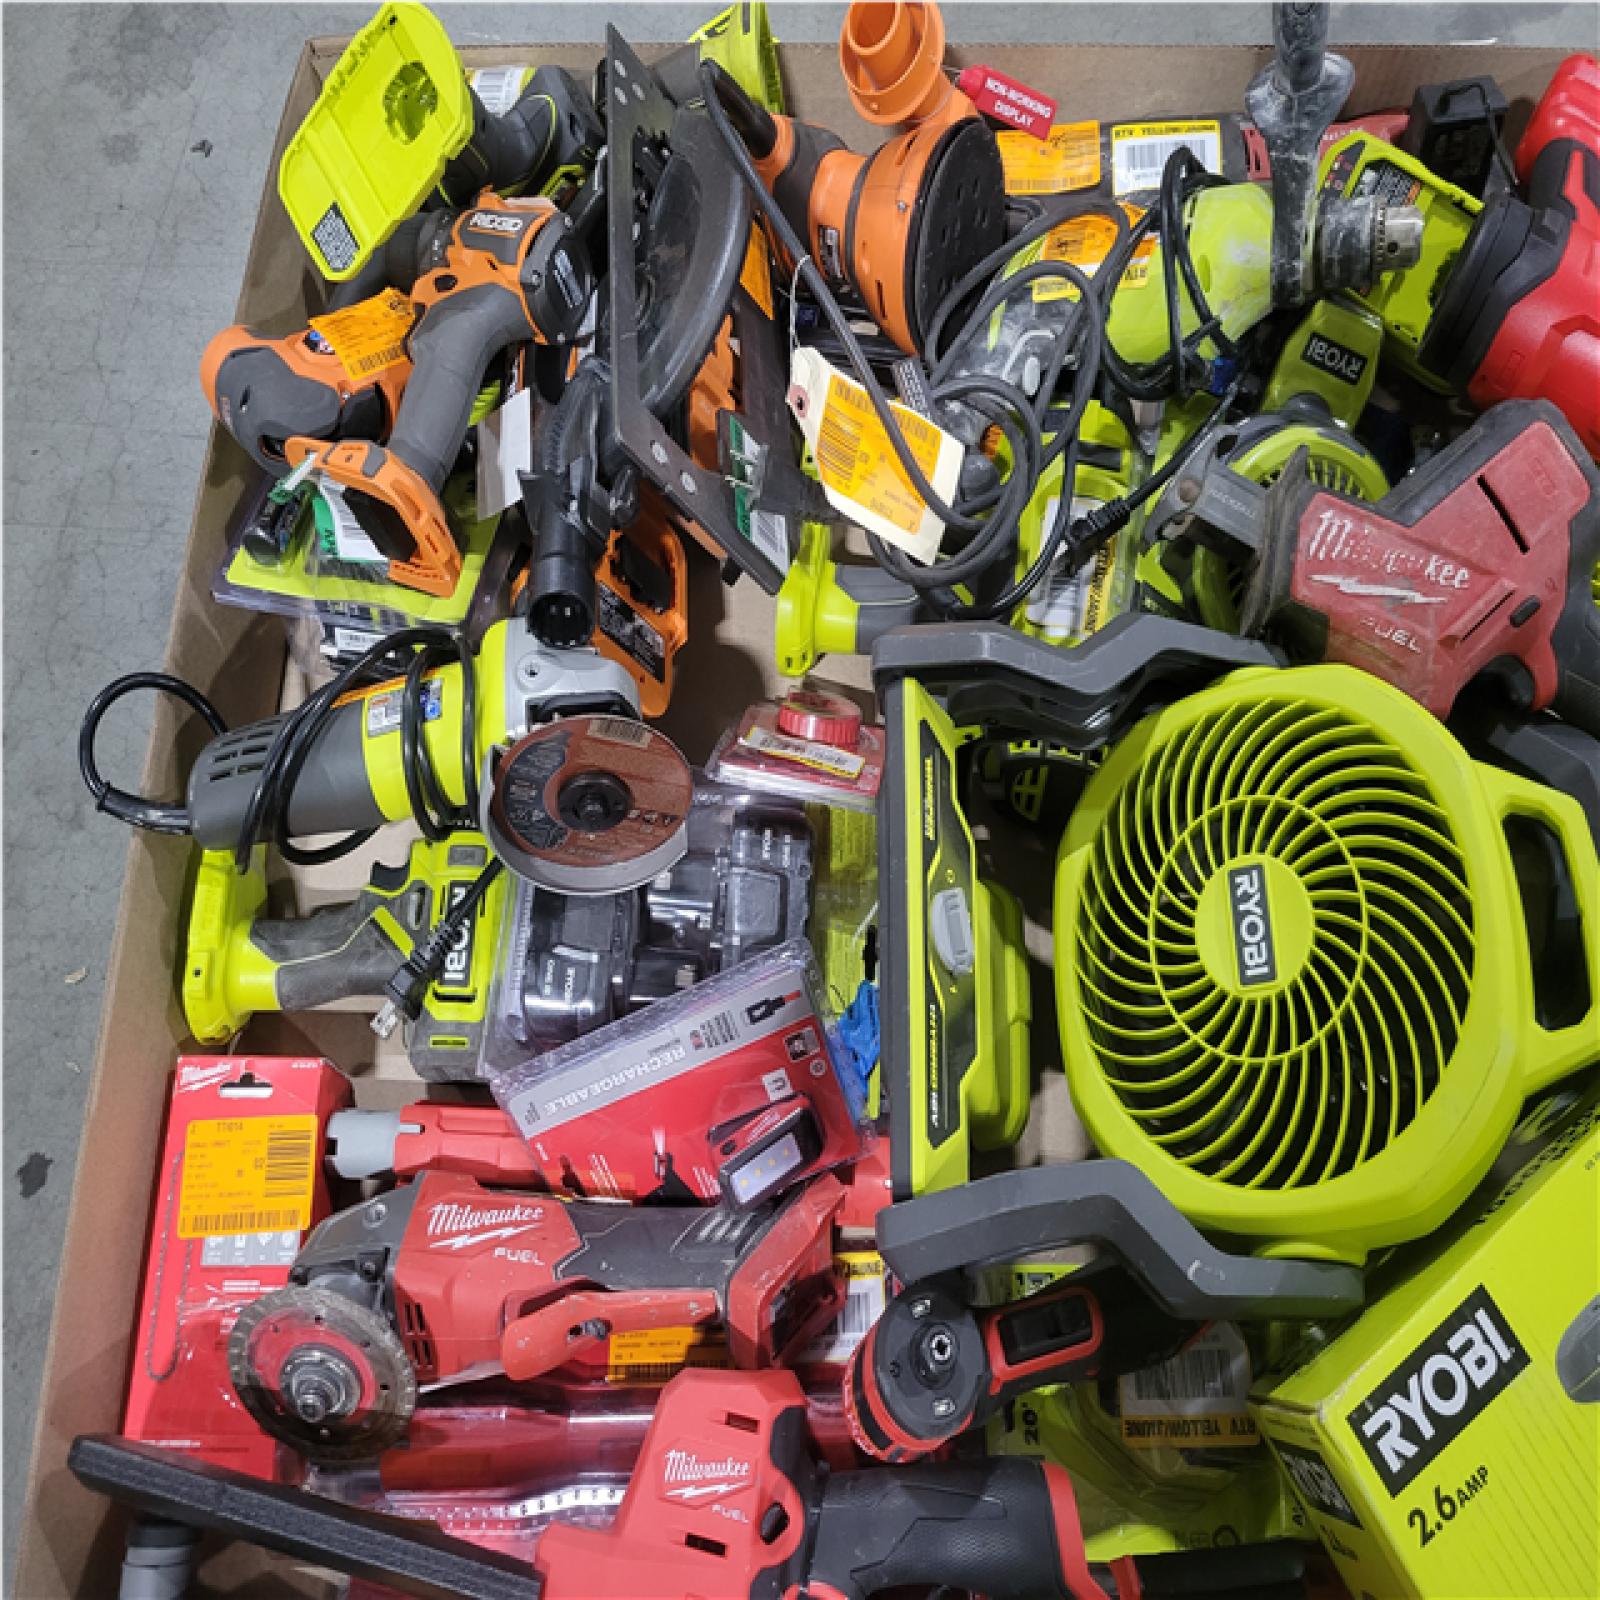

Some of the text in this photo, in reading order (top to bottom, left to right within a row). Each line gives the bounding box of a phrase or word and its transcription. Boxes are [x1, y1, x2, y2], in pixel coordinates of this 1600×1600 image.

[985, 77, 1050, 118] NON-WORKING
[994, 100, 1034, 127] DISPLAY
[1307, 337, 1363, 379] RYOBI
[1234, 869, 1270, 976] RYOBI
[545, 1046, 687, 1116] RECHARGEABLE
[427, 1202, 544, 1236] Milwaukee
[494, 1247, 545, 1266] FUEL
[1362, 1307, 1514, 1473] RYOBI
[664, 1449, 749, 1483] Milwaukee
[711, 1504, 750, 1524] FUEL
